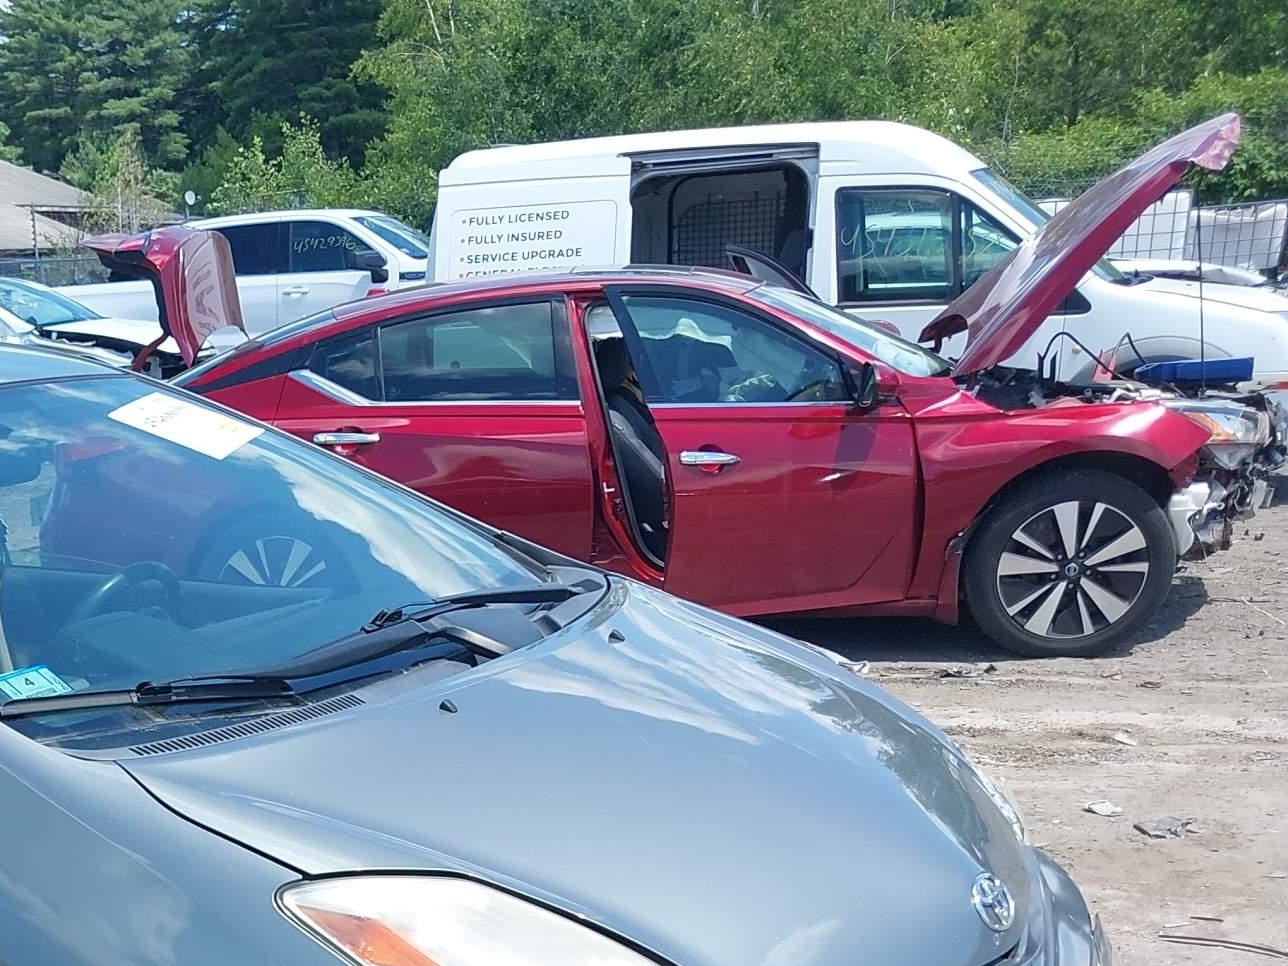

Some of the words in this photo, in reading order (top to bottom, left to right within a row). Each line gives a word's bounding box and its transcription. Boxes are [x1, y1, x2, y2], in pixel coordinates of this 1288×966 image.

[469, 215, 504, 226] FULLY
[508, 210, 570, 224] LICENSED
[468, 234, 504, 245] FULLY
[507, 230, 563, 243] INSURED
[467, 252, 518, 264] SERVICE
[522, 247, 583, 260] UPGRADE
[24, 677, 35, 686] 4
